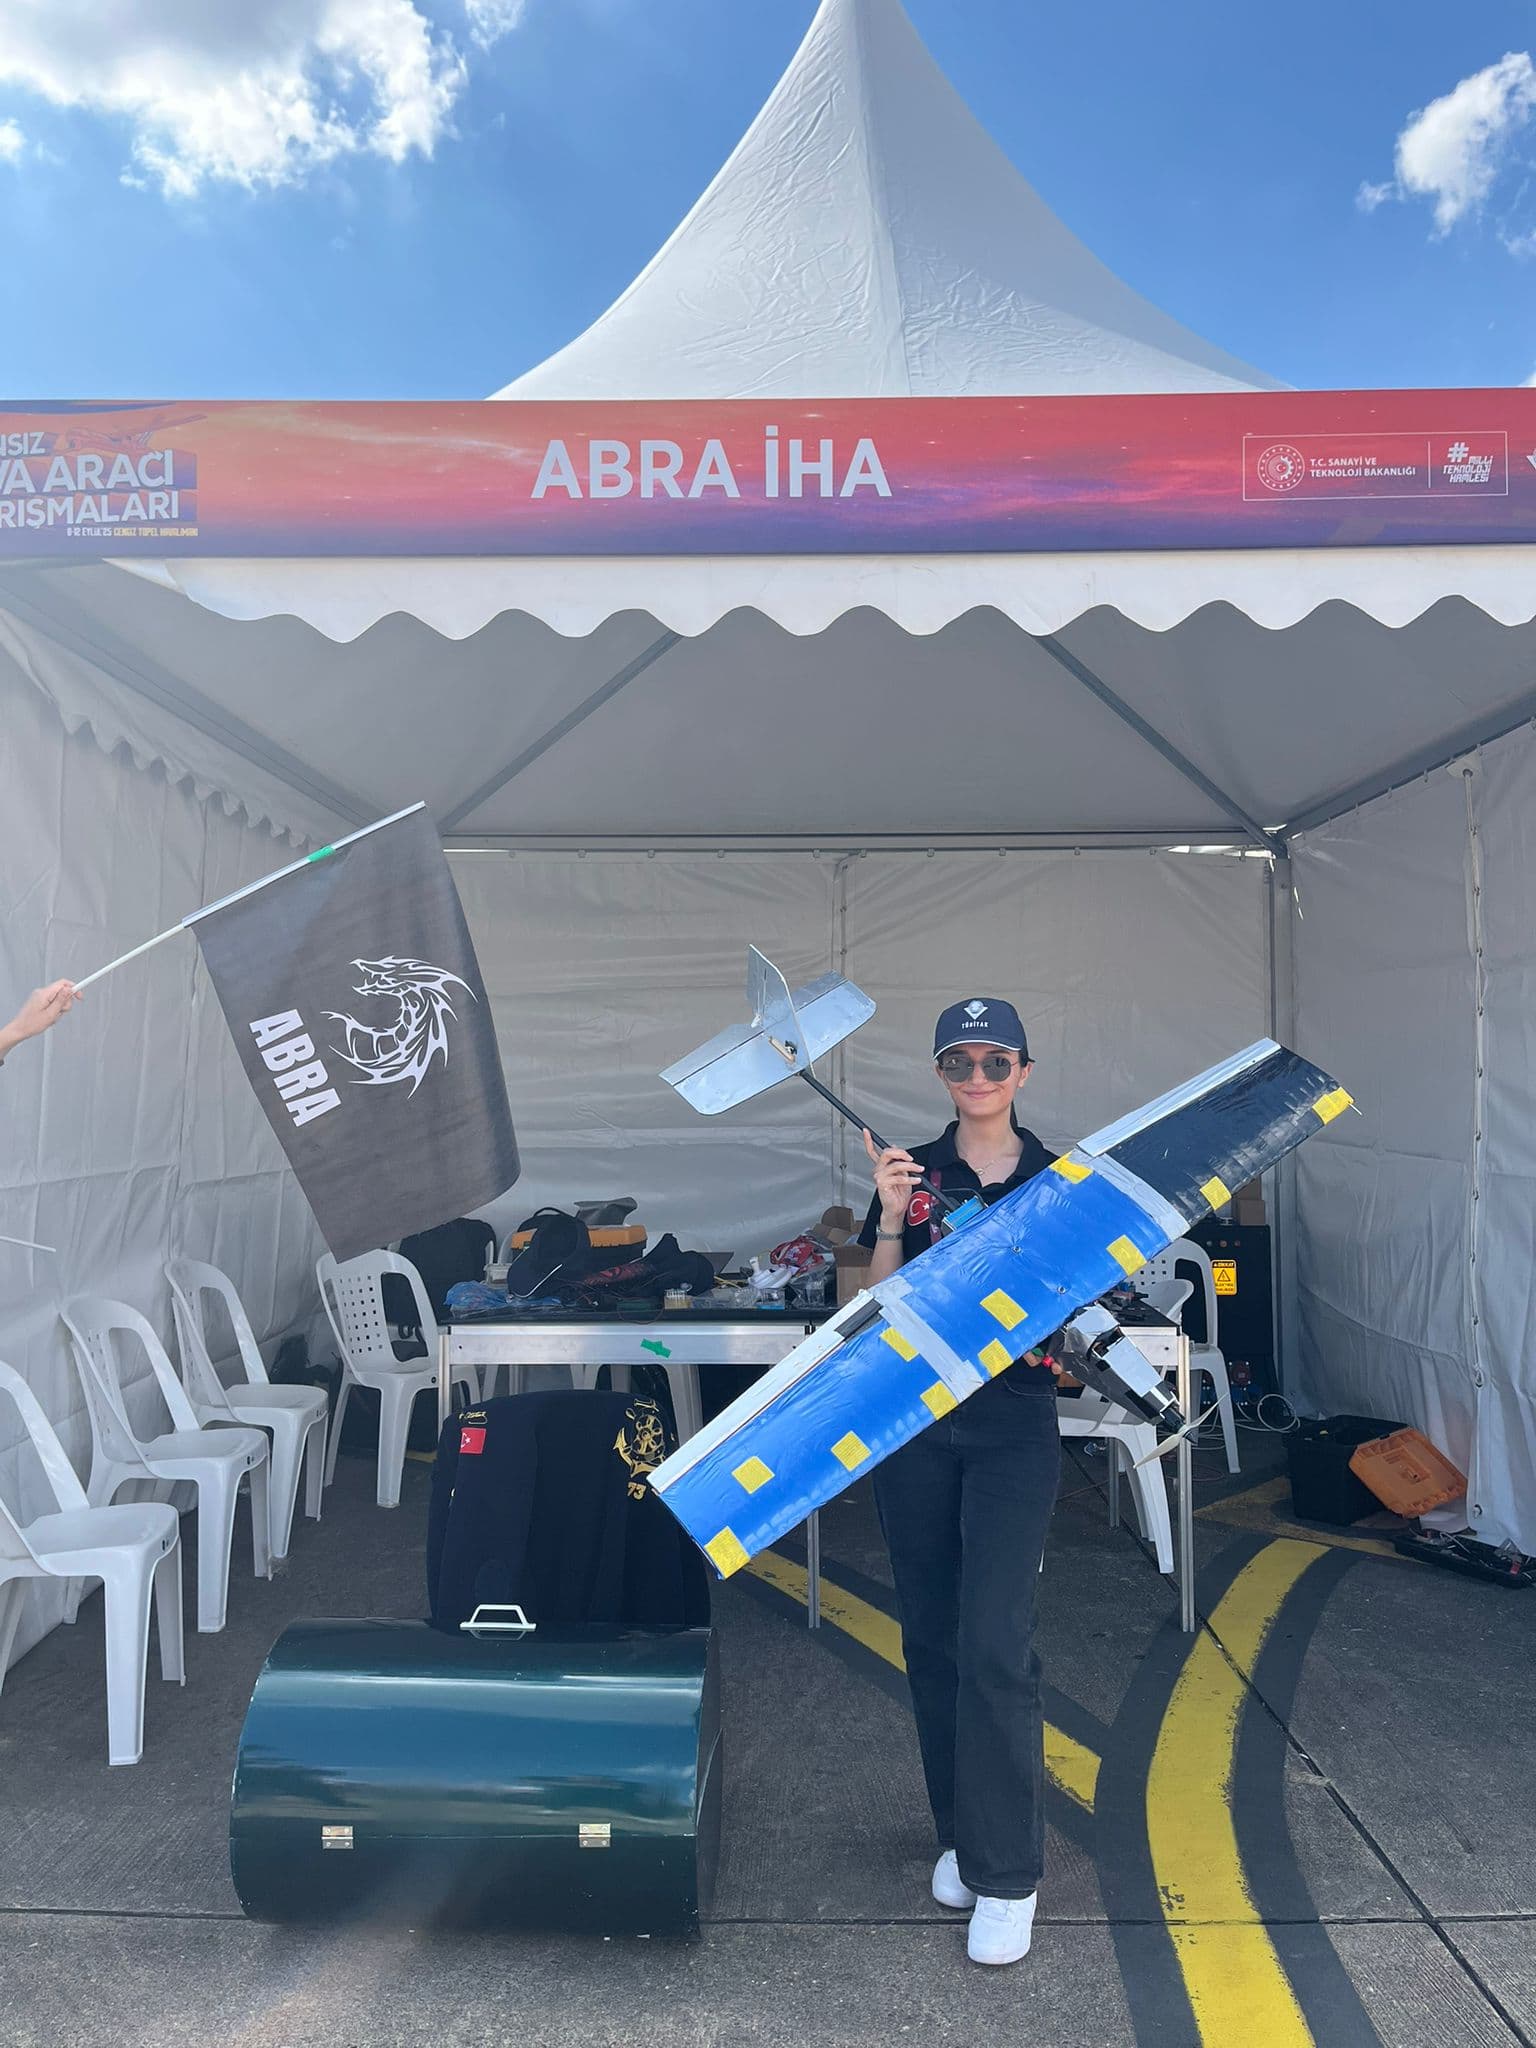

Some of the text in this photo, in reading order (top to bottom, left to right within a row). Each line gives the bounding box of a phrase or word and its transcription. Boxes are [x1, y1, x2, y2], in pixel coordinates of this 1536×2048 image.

[43, 449, 174, 491] ARACI
[530, 425, 892, 498] ABRA İHA
[1310, 455, 1377, 467] T.C. SANAYİ VE
[1310, 466, 1416, 478] TEKNOLOJİ BAKANLIĞI
[249, 1008, 342, 1127] ABRA
[628, 1483, 646, 1500] 73
